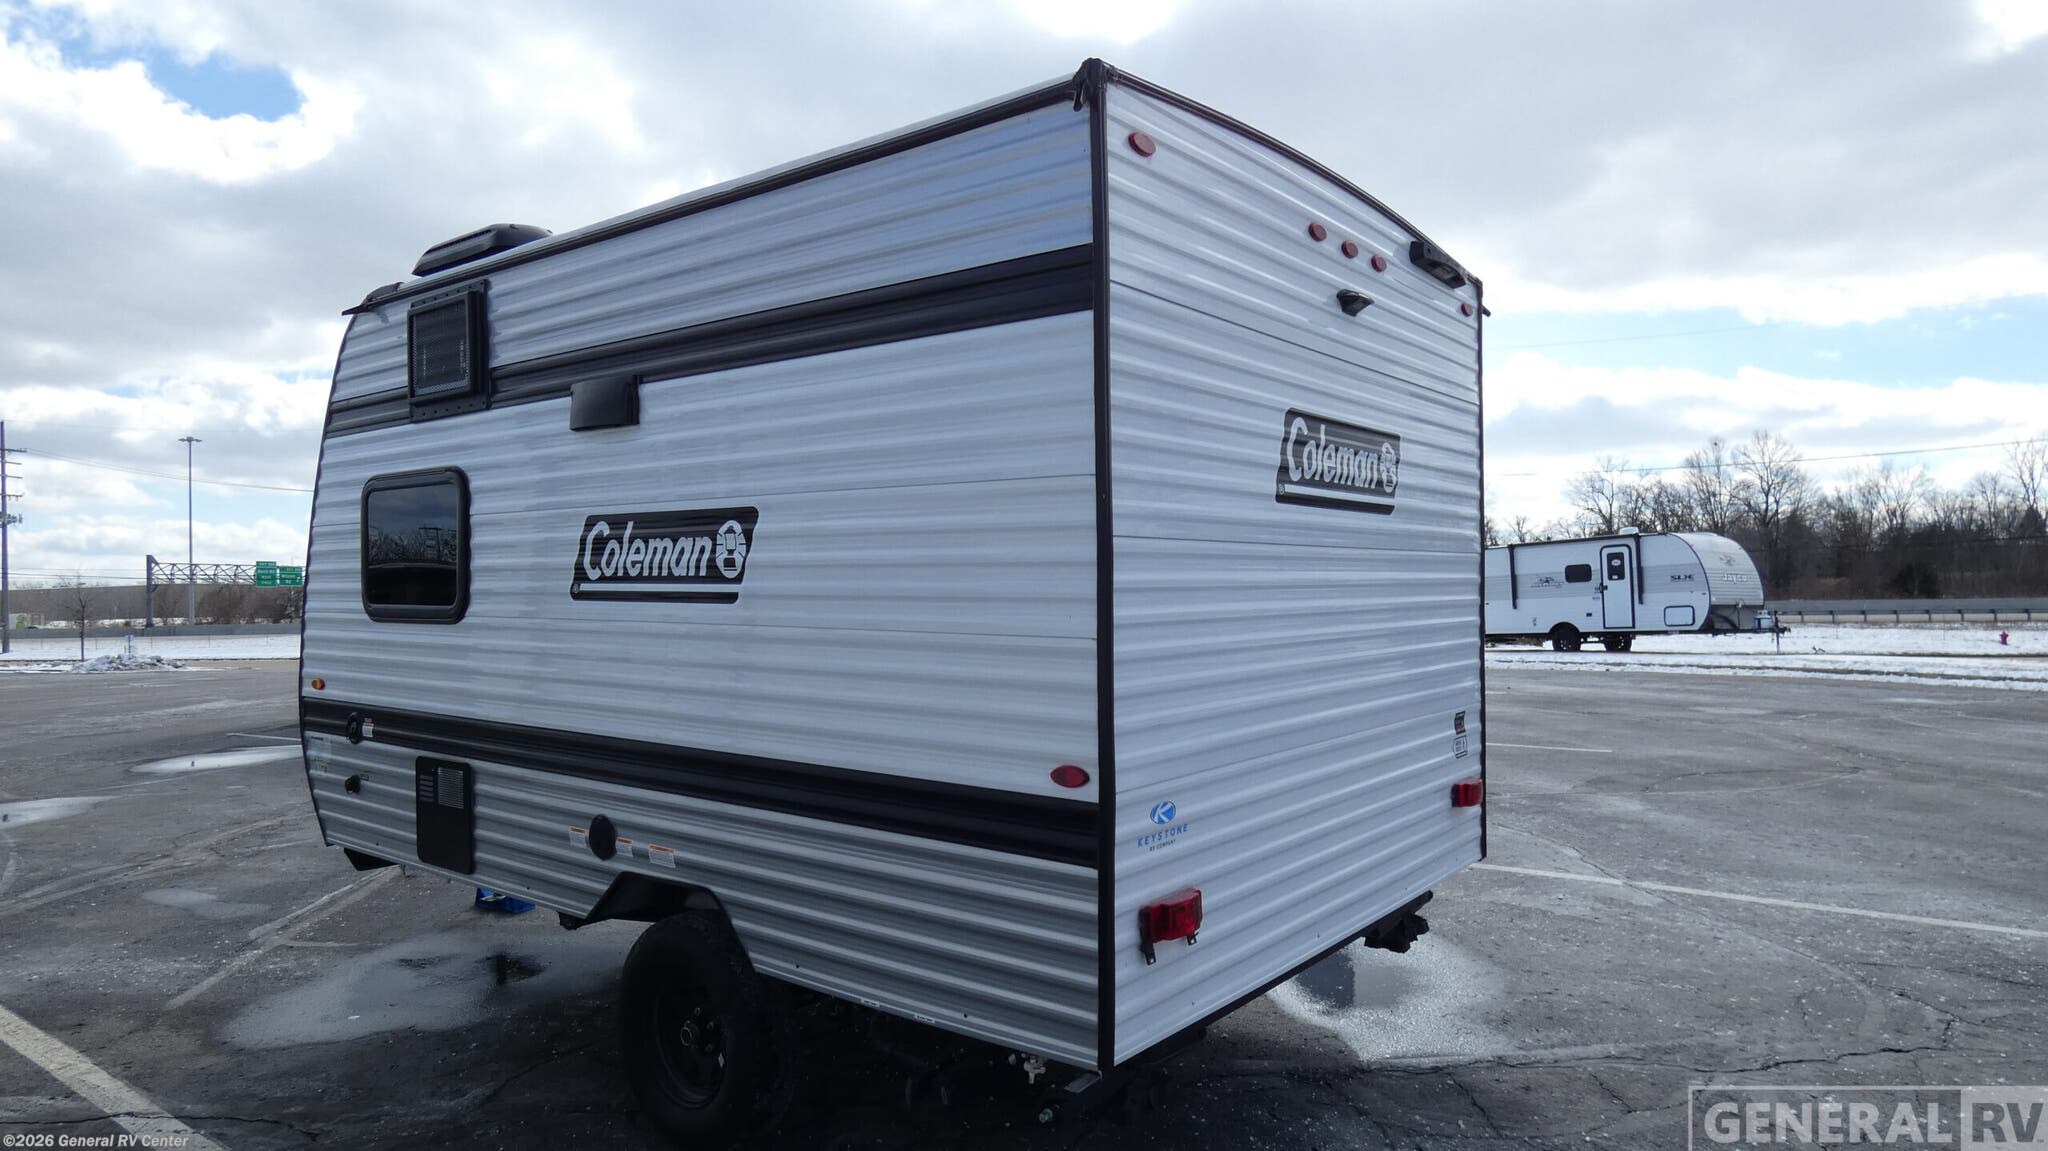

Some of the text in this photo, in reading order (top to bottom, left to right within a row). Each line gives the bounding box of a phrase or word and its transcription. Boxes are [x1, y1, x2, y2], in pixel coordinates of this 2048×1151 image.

[1286, 416, 1379, 490] Coleman
[583, 520, 713, 581] Coleman
[1137, 823, 1189, 848] KEYSTONE
